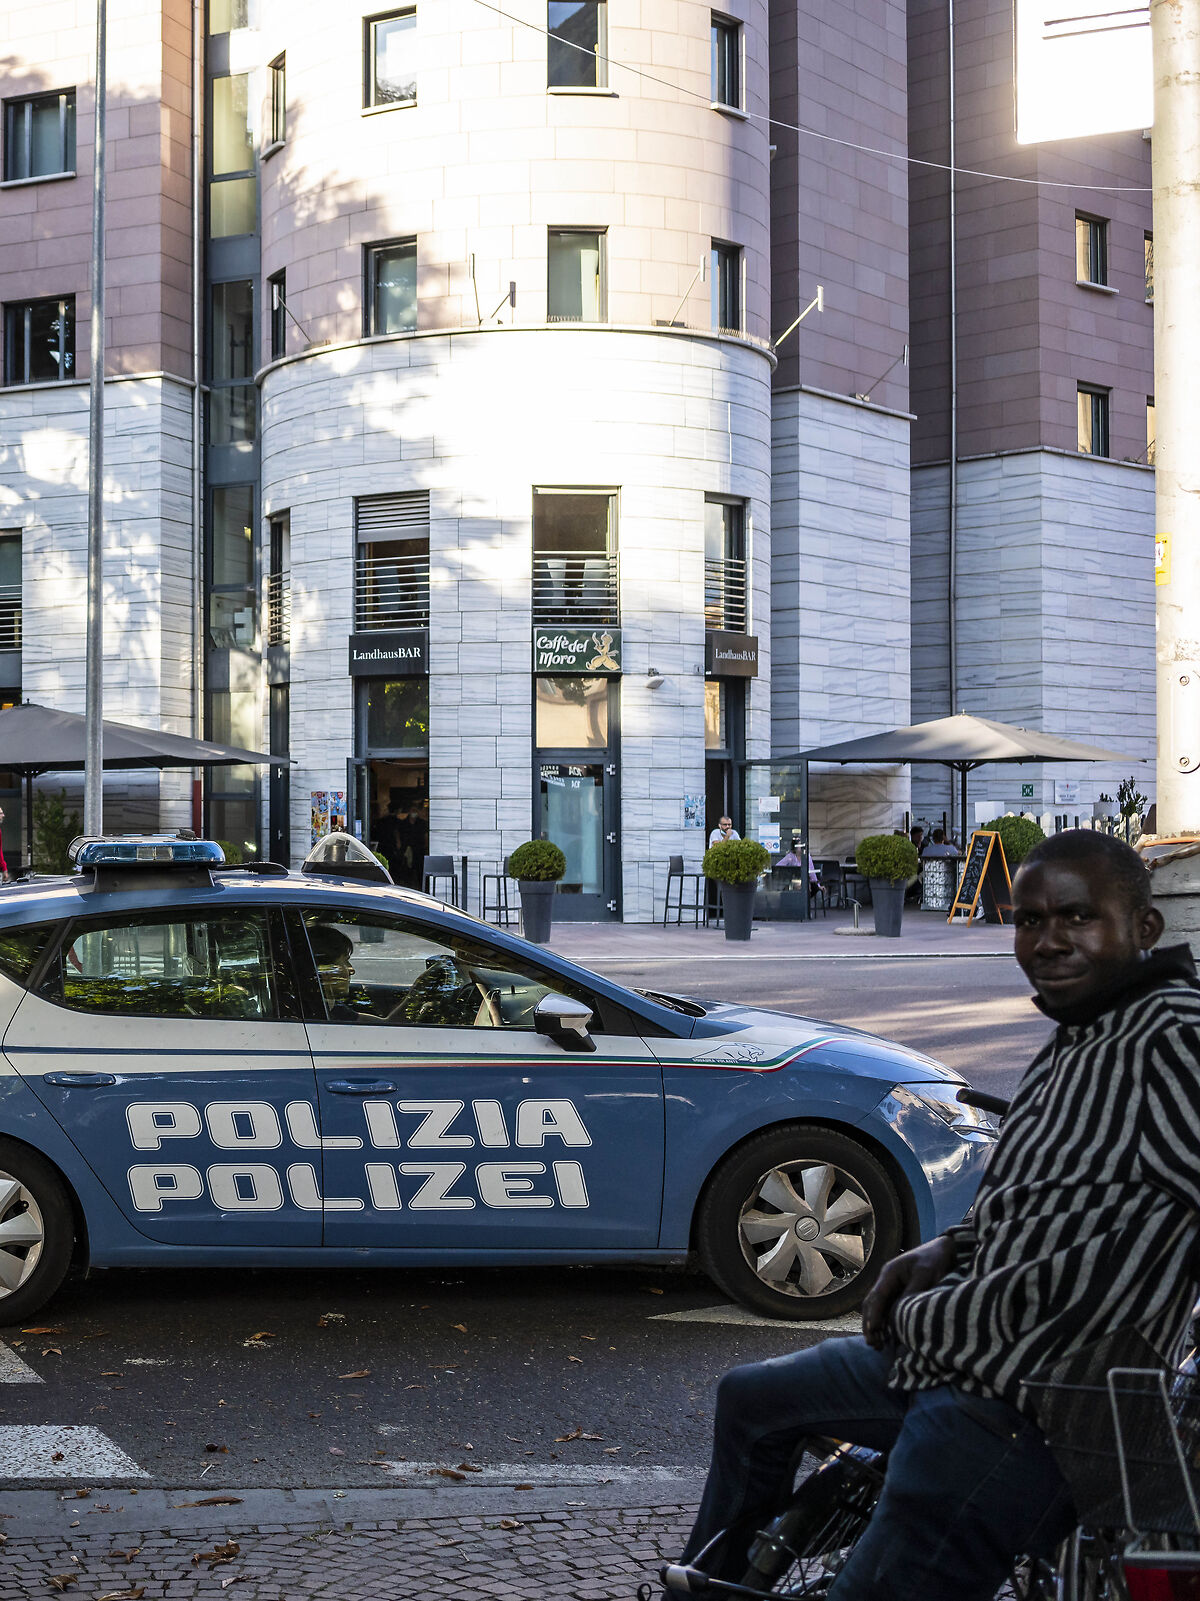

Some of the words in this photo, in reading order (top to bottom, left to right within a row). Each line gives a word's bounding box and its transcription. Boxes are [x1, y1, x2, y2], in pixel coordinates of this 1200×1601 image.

[536, 635, 569, 653] Caffè
[568, 639, 589, 653] del
[353, 647, 421, 660] LandhausBAR
[539, 651, 576, 668] Moro
[715, 648, 756, 661] LandhausBAR
[125, 1098, 593, 1151] POLIZIA
[126, 1160, 590, 1212] POLIZEI
